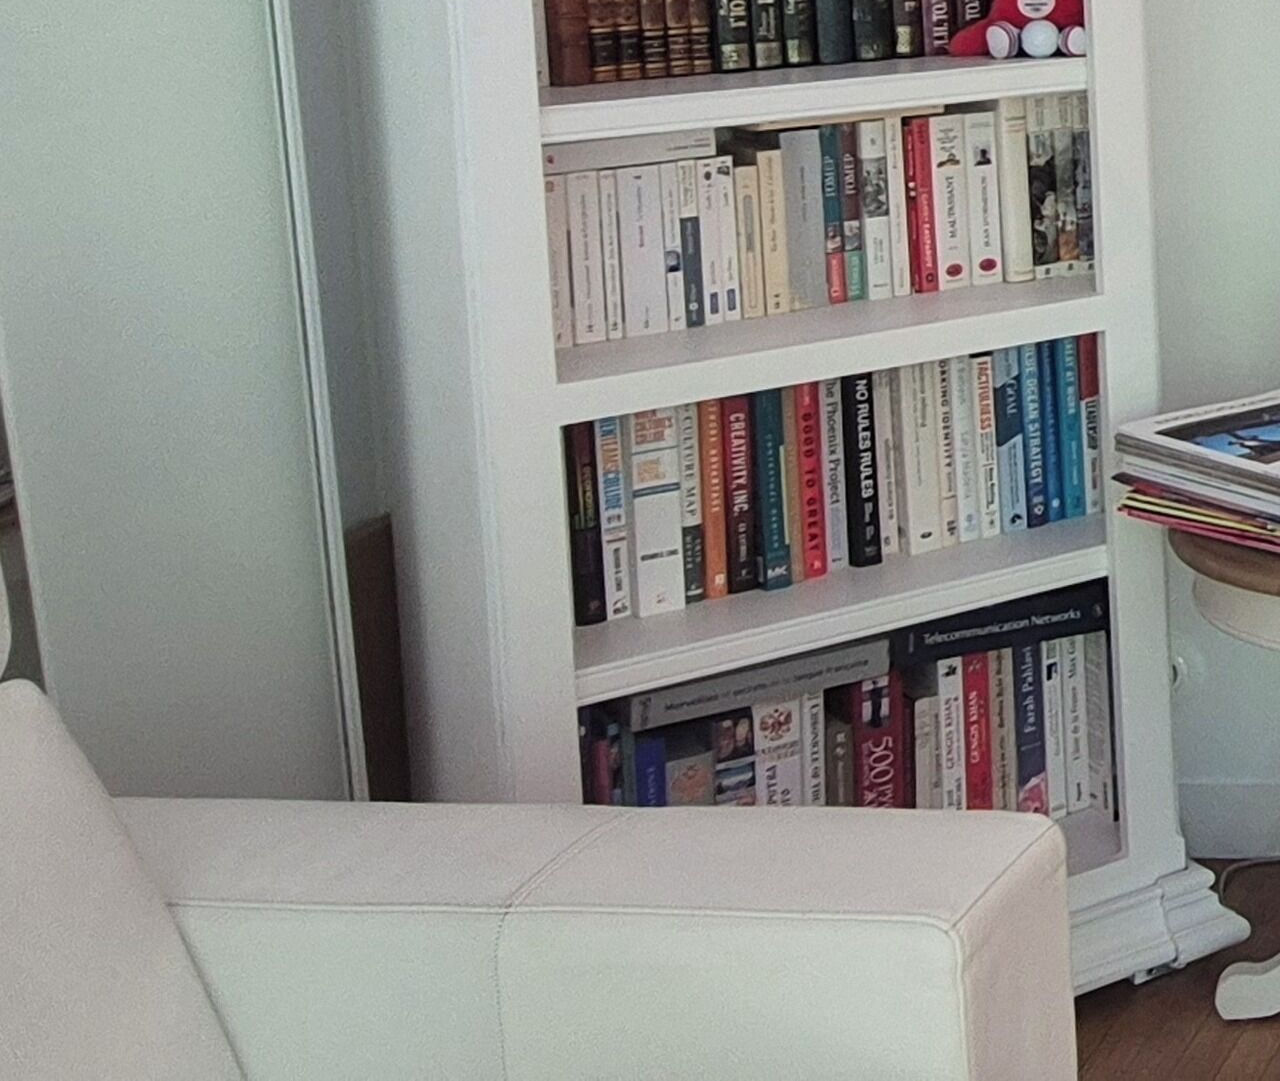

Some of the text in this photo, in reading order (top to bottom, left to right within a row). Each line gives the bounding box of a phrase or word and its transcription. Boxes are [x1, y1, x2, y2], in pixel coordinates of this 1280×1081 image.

[823, 156, 835, 197] ГОМЕР
[843, 153, 856, 194] ГОМЕР
[945, 175, 957, 239] MAUPASSANT
[855, 380, 867, 400] NO
[977, 360, 992, 431] FACTFULNESS
[1006, 380, 1017, 418] GOAL
[1028, 380, 1039, 418] OCEAN
[1066, 372, 1076, 382] AT
[826, 402, 839, 455] Phoenix
[857, 404, 871, 449] RULES
[942, 412, 952, 468] IDENTITY
[1086, 401, 1098, 450] LEADERSHIP
[683, 416, 697, 517] CULTURE MAP
[729, 413, 749, 516] CREATIVITY, INC.
[859, 452, 874, 498] RULES
[1029, 423, 1042, 483] STRATEGY
[801, 412, 820, 553] GOOD TO GREAT
[828, 459, 841, 505] Project
[923, 607, 1082, 647] Telecommunication Networks
[1021, 646, 1037, 733] Farah Pahlavi
[1068, 658, 1076, 679] Max
[944, 698, 954, 769] GENGIS KHAN
[968, 691, 980, 763] GENGIS KHAN
[868, 736, 894, 783] 500
